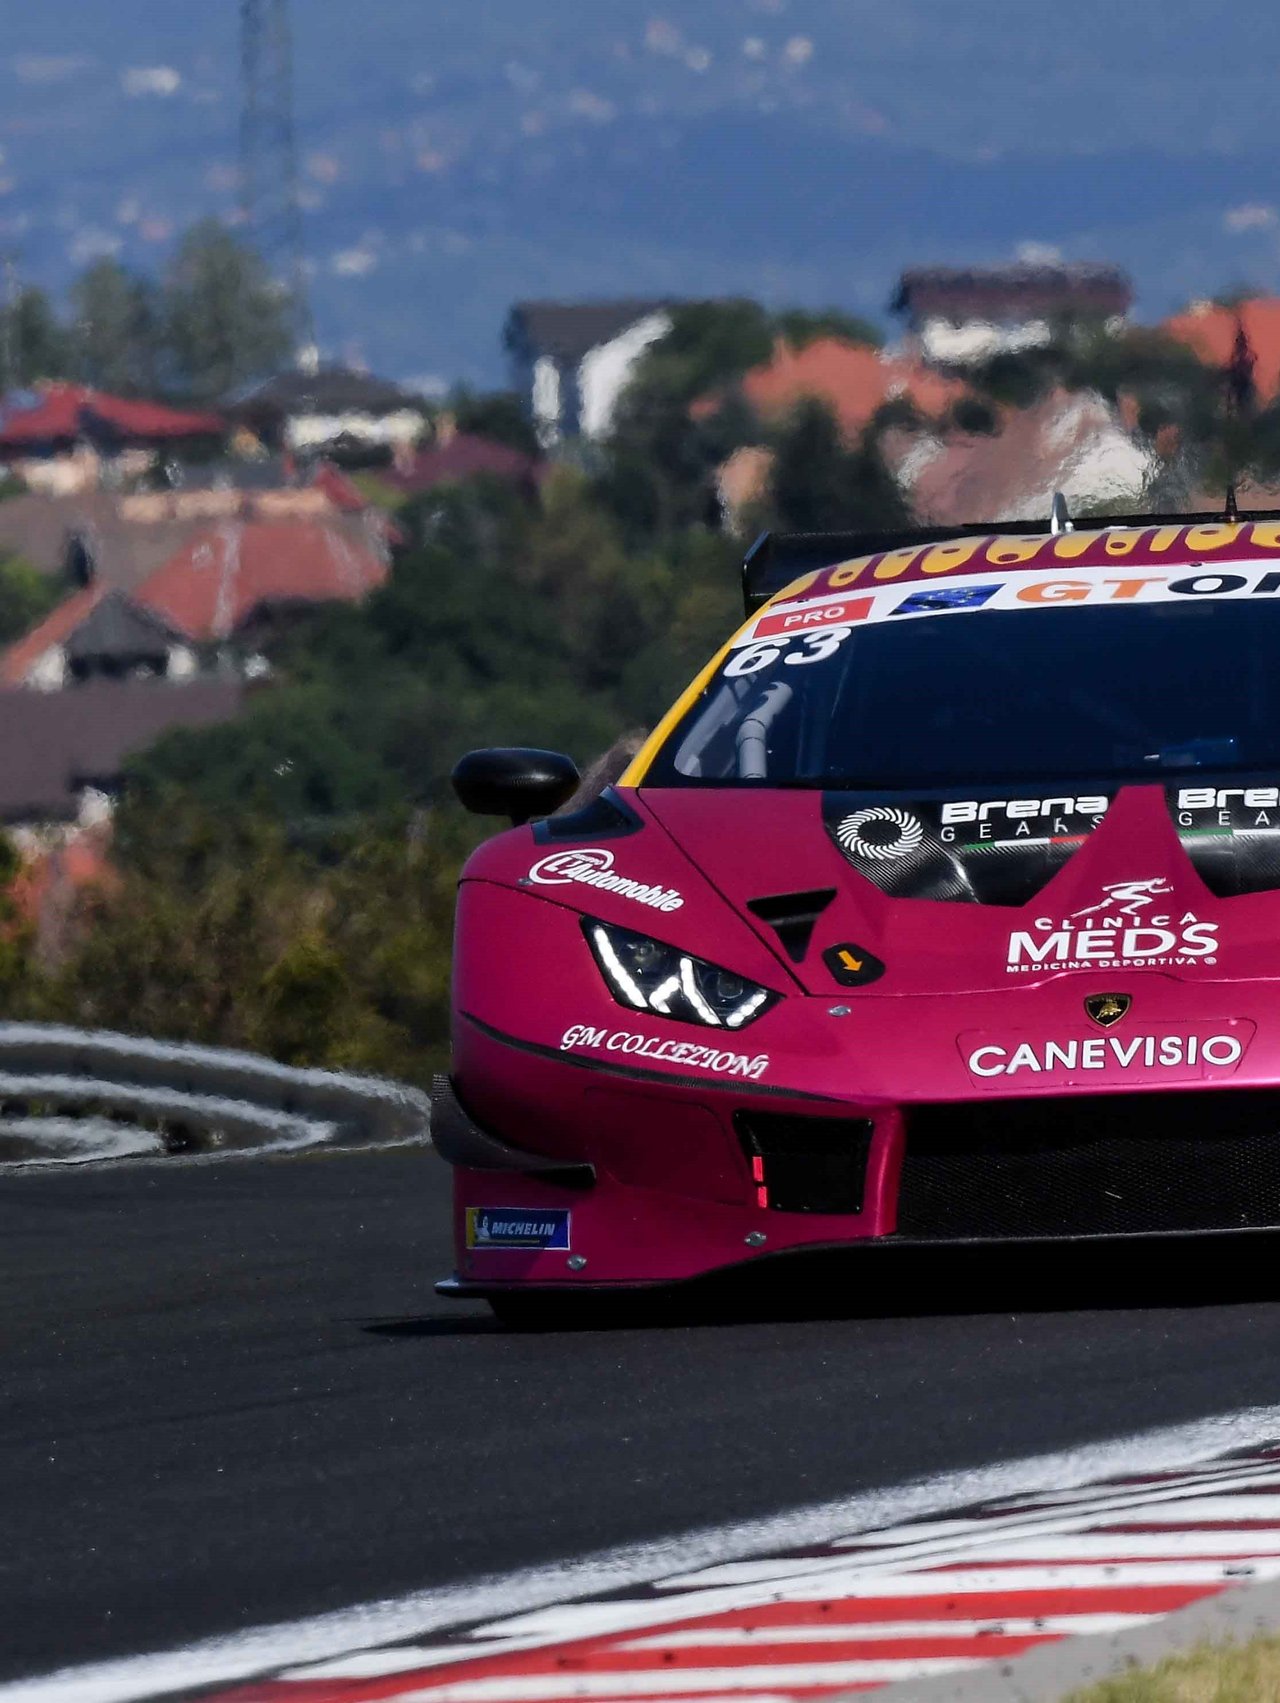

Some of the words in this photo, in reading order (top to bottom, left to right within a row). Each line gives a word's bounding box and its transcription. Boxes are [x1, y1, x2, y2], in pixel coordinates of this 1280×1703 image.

[783, 606, 845, 627] PRO
[723, 627, 852, 677] 63
[941, 796, 1108, 824] Brena
[1034, 911, 1198, 930] CLINICA
[1007, 922, 1220, 963] MEDS
[1006, 960, 1091, 973] MEDICINA
[1099, 956, 1197, 968] DEPORTIVA
[560, 1024, 607, 1051] GM
[606, 1032, 770, 1079] COLLEZIONI
[968, 1035, 1242, 1077] CANEVISIO
[491, 1221, 556, 1236] MICHELIN
